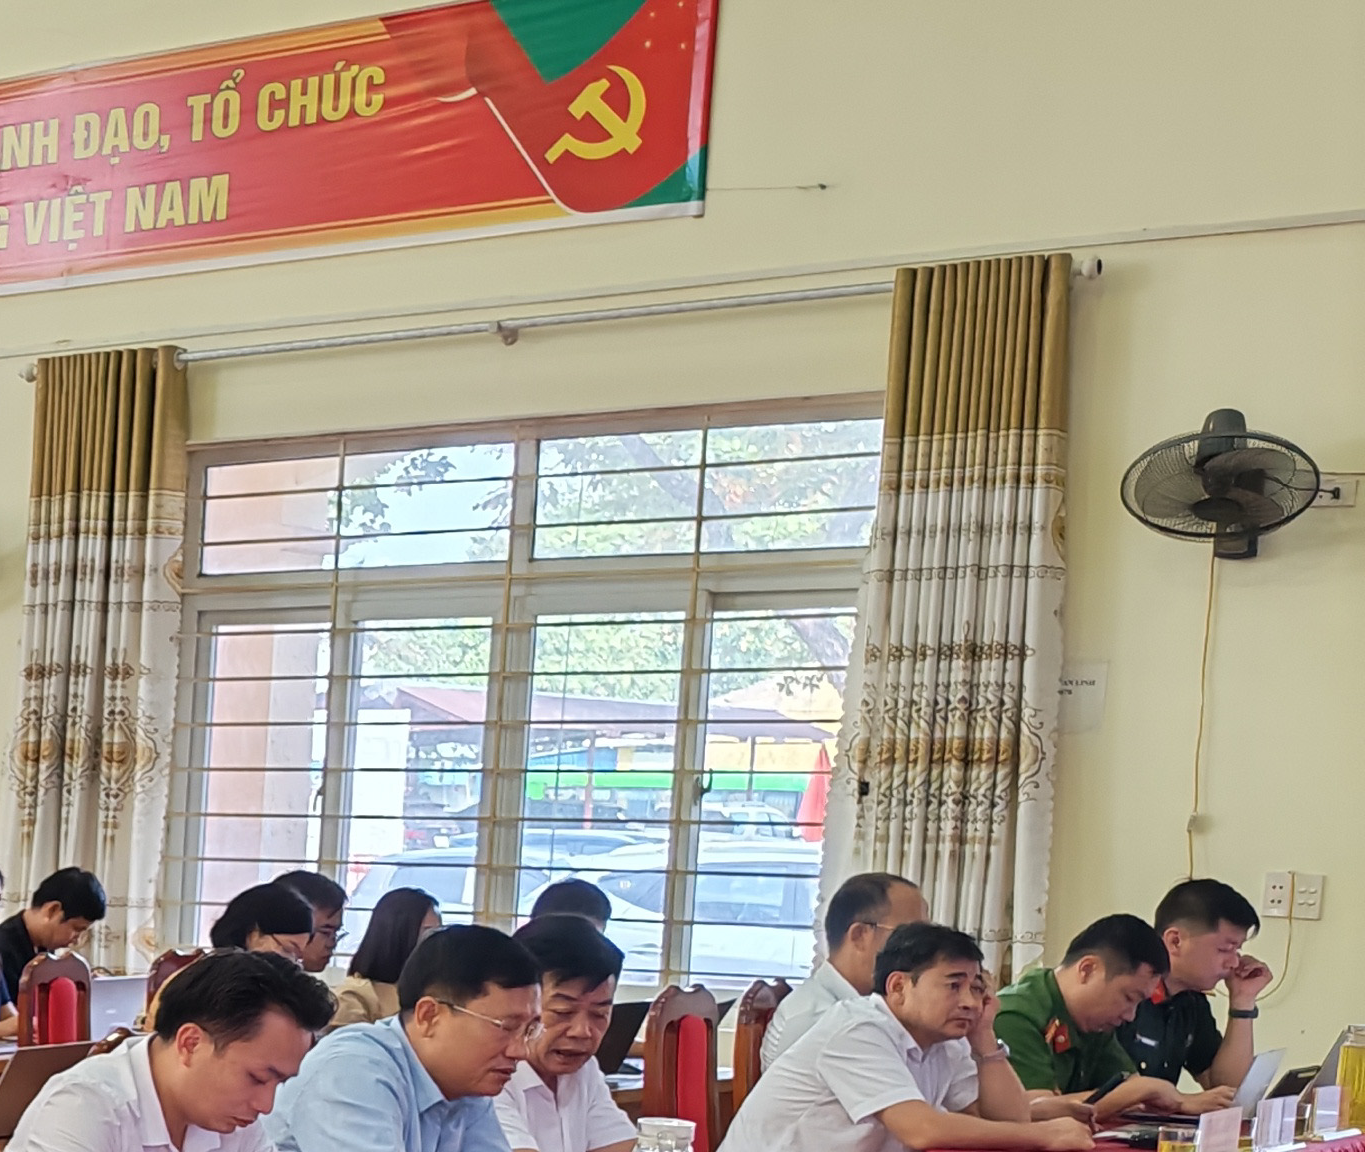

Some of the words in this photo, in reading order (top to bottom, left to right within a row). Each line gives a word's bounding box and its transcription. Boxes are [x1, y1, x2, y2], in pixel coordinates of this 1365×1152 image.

[73, 102, 170, 165] ĐẠO,
[187, 68, 246, 142] TỔ
[256, 60, 386, 132] CHỨC
[24, 186, 112, 250] VIỆT
[124, 174, 230, 234] NAM
